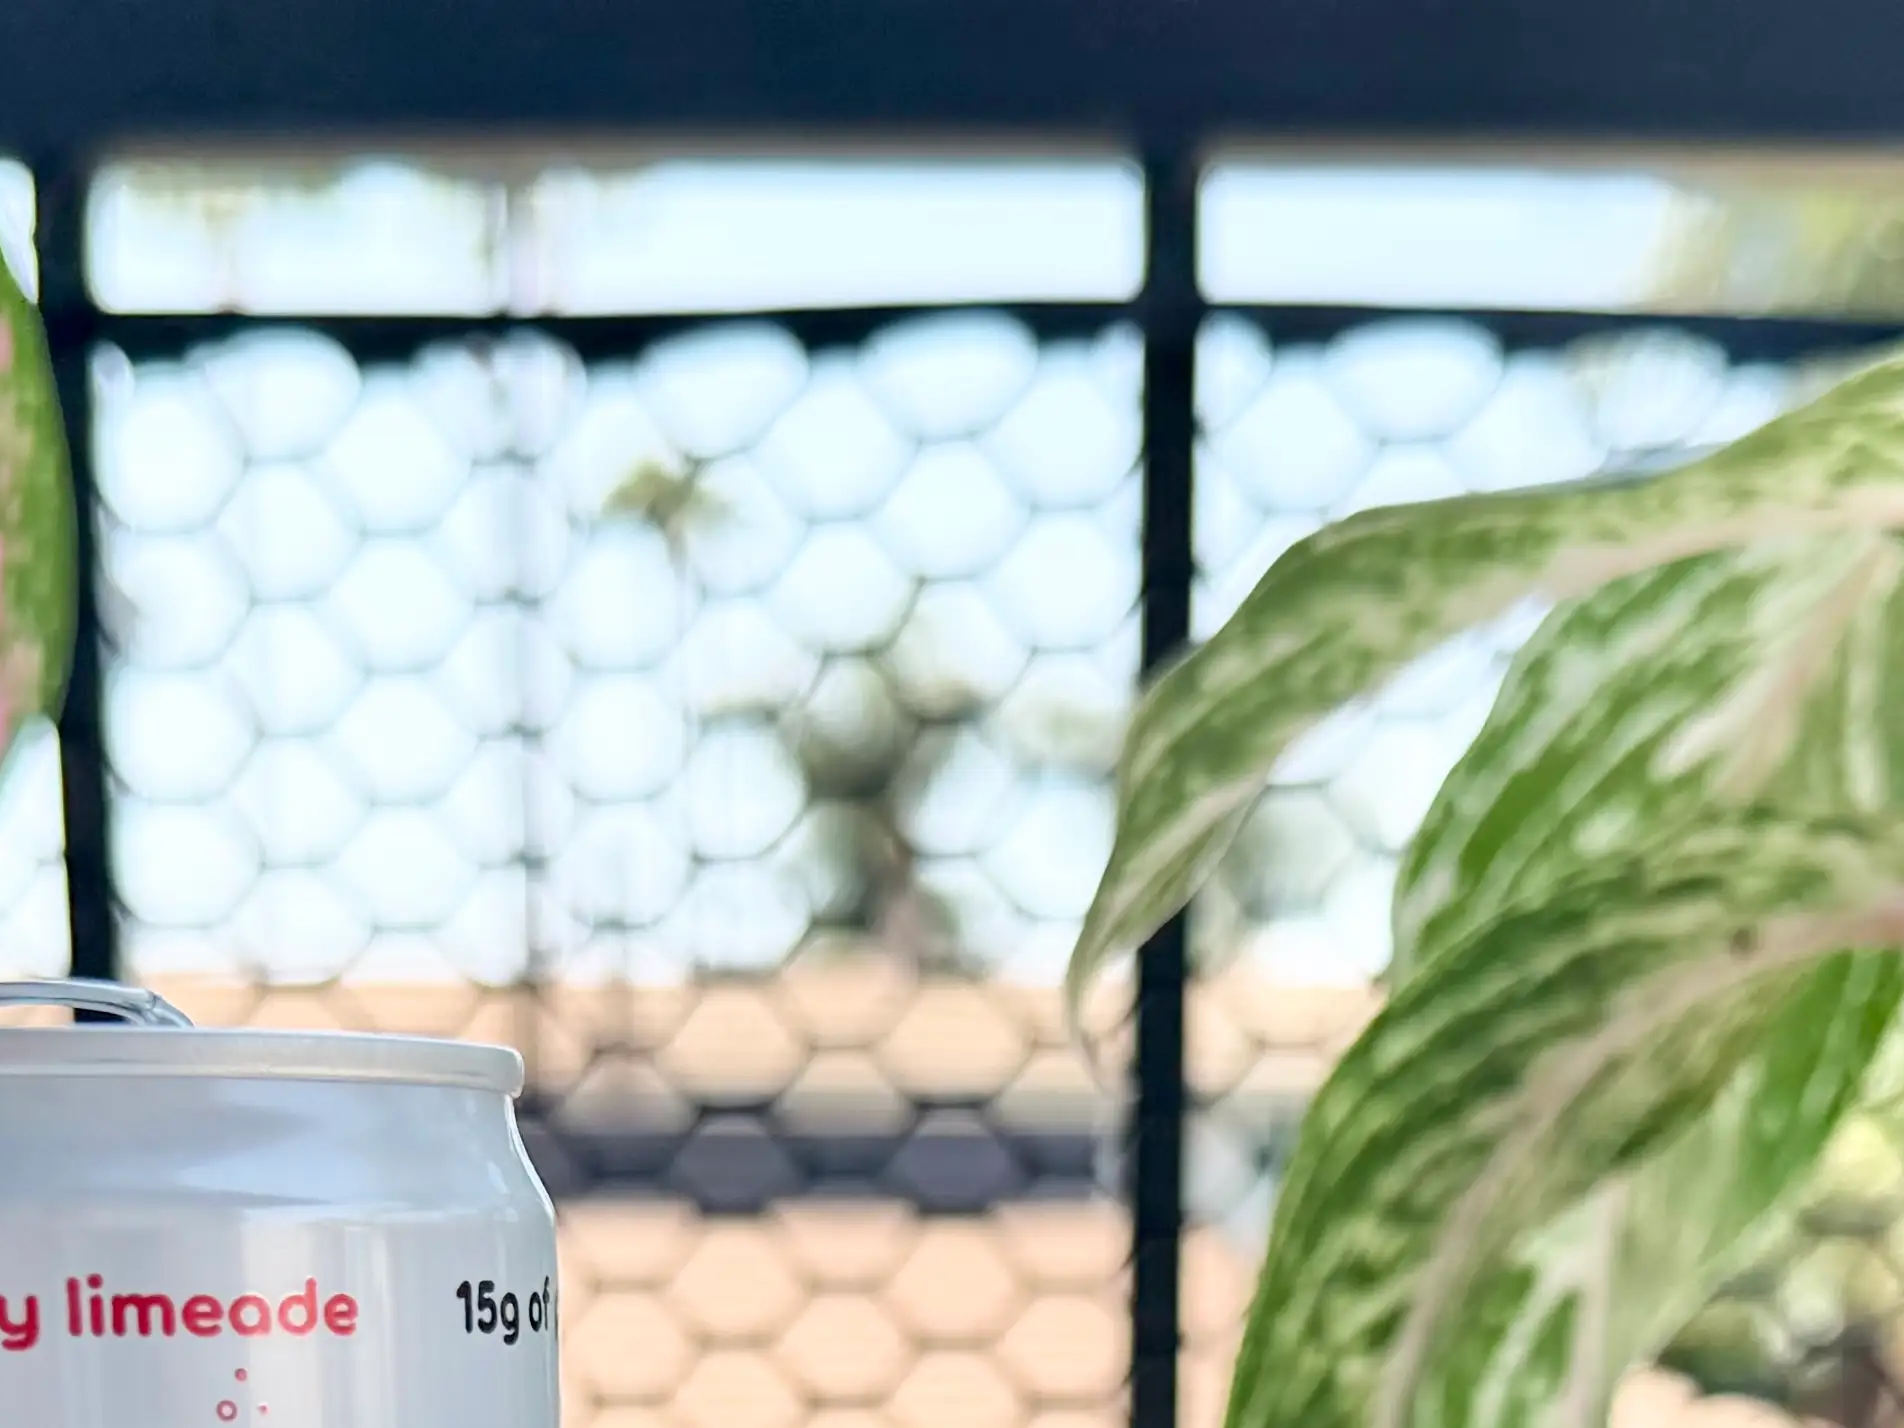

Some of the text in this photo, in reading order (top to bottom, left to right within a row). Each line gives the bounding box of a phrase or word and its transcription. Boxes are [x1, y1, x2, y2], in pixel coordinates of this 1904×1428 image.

[66, 1273, 359, 1338] limeade
[456, 1274, 550, 1346] 15g of
